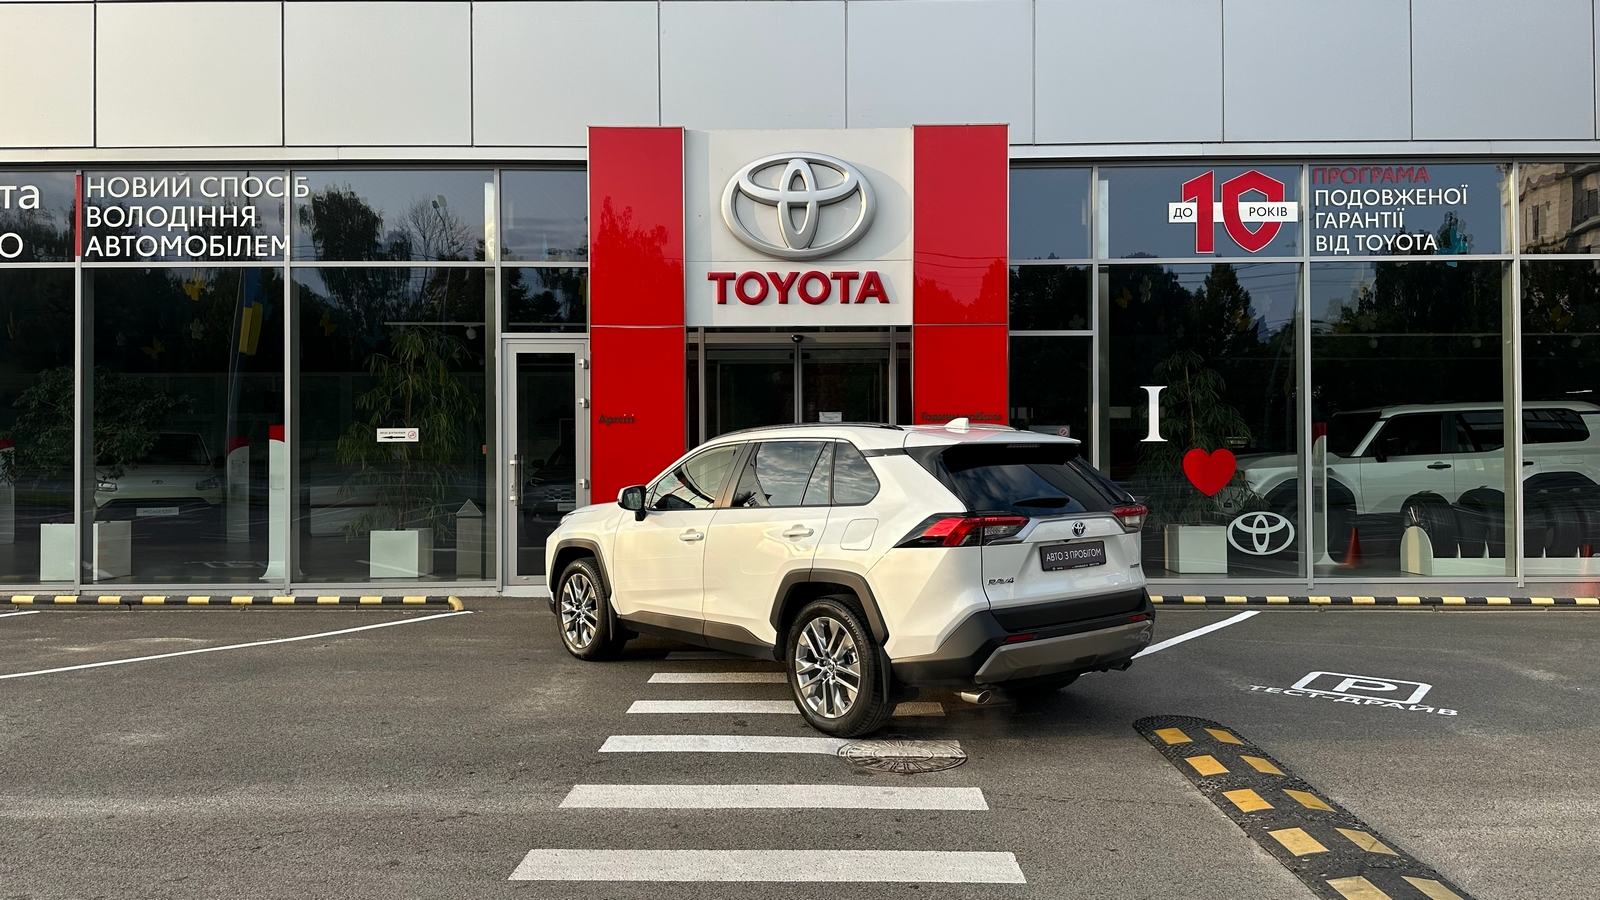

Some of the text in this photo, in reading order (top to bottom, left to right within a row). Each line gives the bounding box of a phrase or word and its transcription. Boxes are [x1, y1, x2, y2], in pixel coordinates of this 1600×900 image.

[87, 171, 310, 198] НОВИЙ СПОСІБ
[1312, 166, 1431, 185] ПРОГРАМА
[1314, 184, 1468, 209] ПОДОВЖЕНОЇ
[86, 205, 256, 231] ВОЛОДІННЯ
[1173, 169, 1288, 253] ДО 10 РОКІВ
[1314, 208, 1404, 229] ГАРАНТІЇ
[85, 235, 291, 257] АВТОМОБІЛЕМ
[1315, 234, 1438, 254] ВІД TOYOTA
[707, 271, 890, 306] TOYOTA
[1045, 551, 1064, 562] АВТО
[1070, 548, 1102, 560] ПРОБІГОМ
[1249, 684, 1458, 716] ТЕСТ-ДРАЙВ
